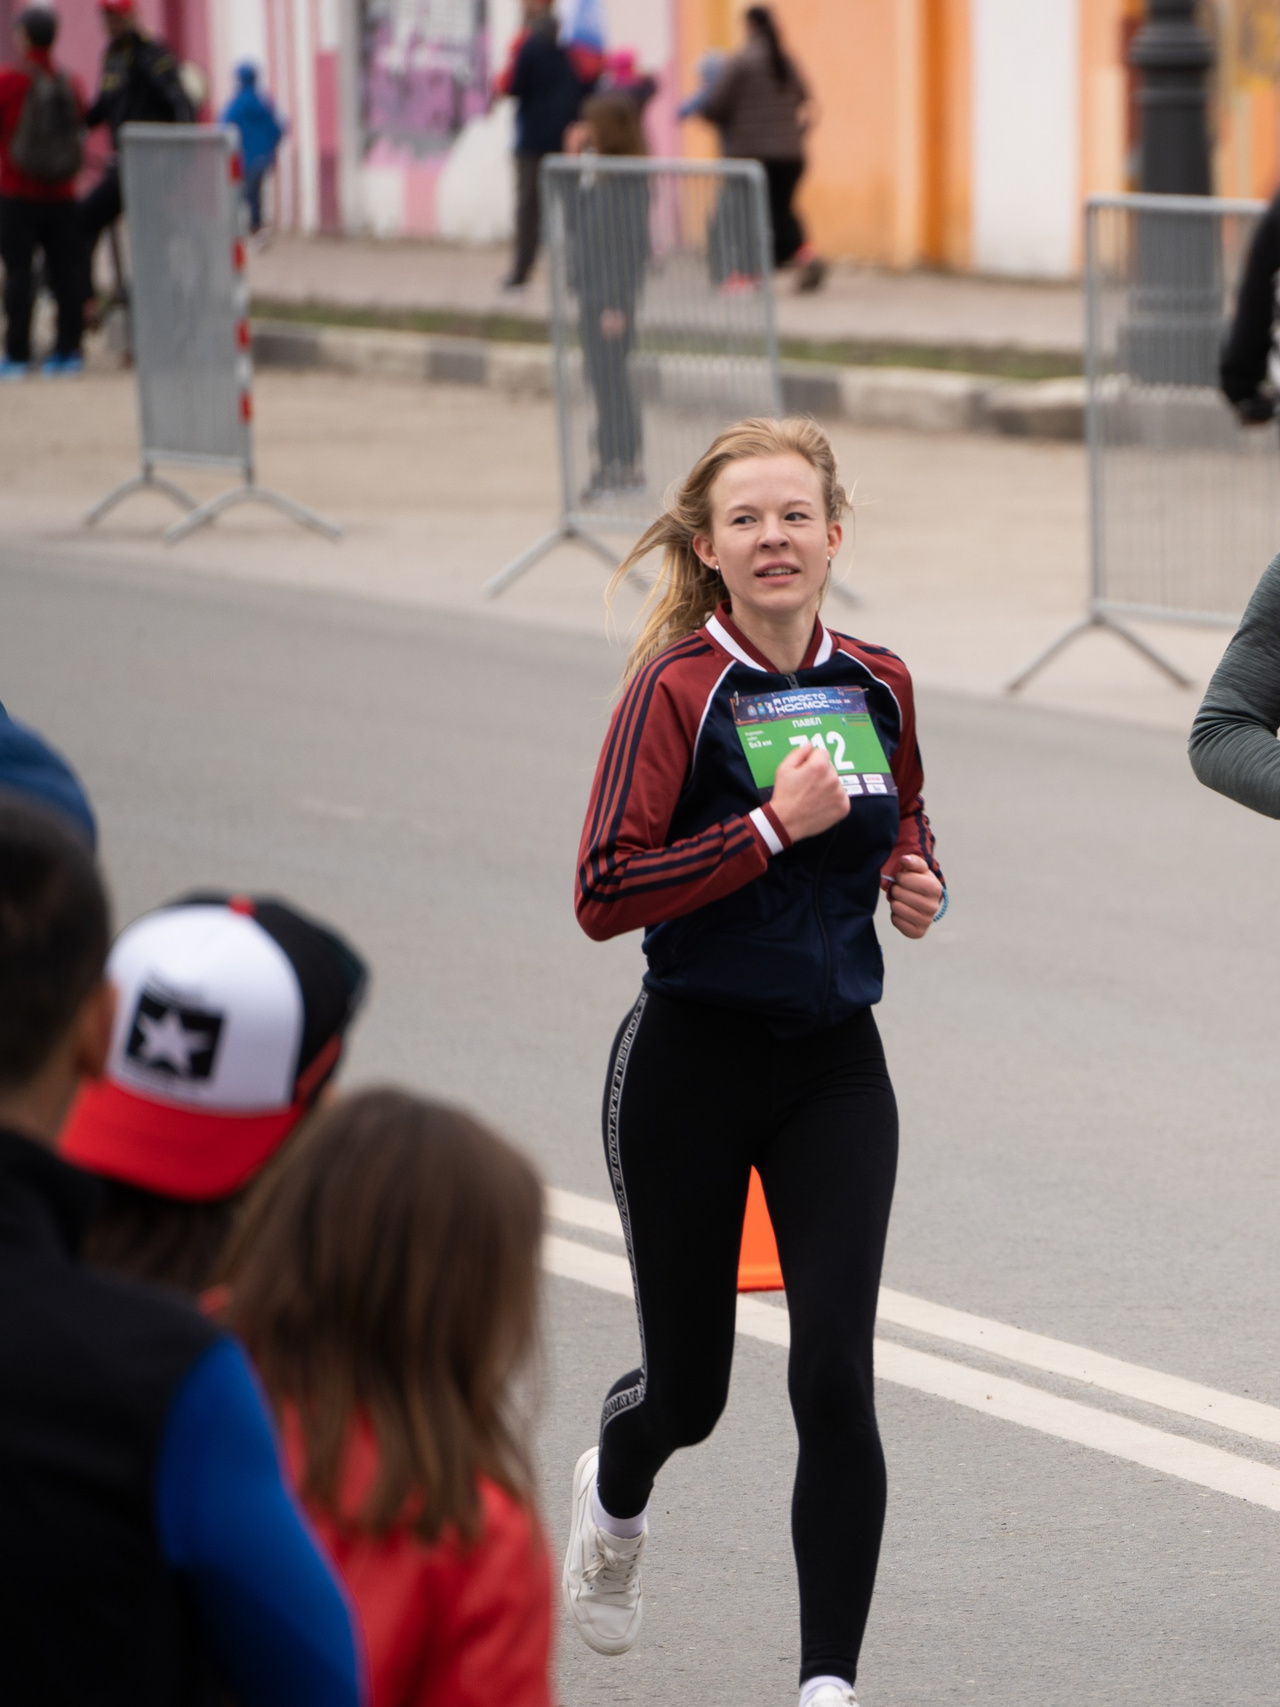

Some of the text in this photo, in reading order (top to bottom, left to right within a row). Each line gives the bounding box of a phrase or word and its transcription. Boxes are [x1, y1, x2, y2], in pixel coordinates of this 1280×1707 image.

[782, 693, 827, 704] ПРОСТО
[792, 717, 822, 728] ПАВЕЛ
[614, 1010, 641, 1085] YOURSELF
[609, 1086, 620, 1123] PLAY
[608, 1124, 619, 1166] LOUD
